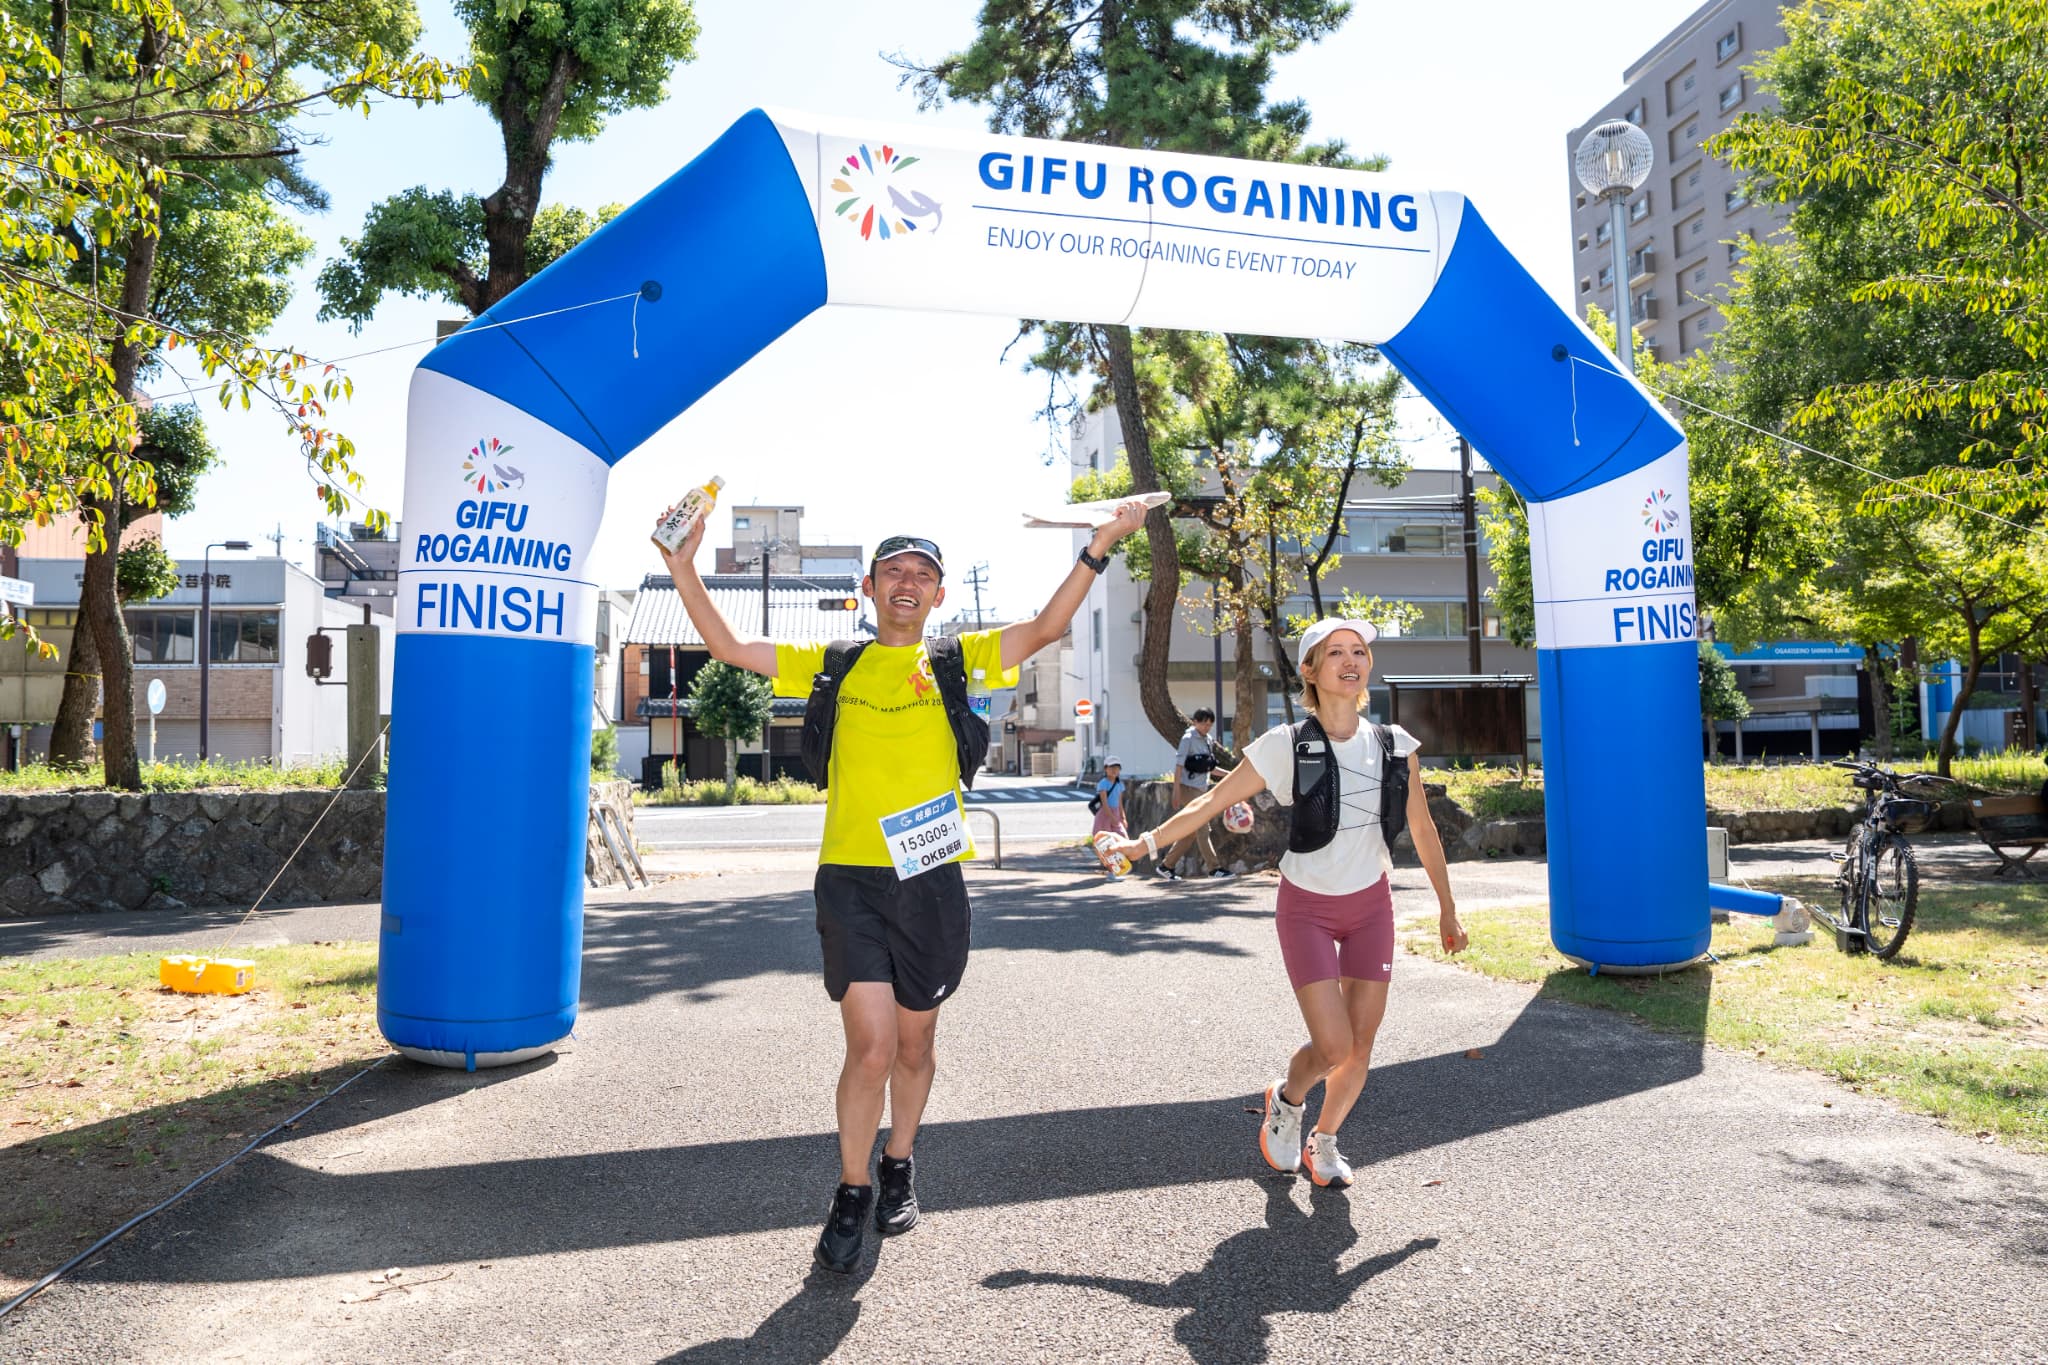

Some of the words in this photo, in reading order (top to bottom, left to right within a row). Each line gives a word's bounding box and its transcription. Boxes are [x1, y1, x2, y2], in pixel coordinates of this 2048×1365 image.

[977, 151, 1108, 201] GIFU
[1127, 165, 1419, 234] ROGAINING
[987, 226, 1054, 251] ENJOY
[1059, 232, 1106, 257] OUR
[1110, 237, 1222, 268] ROGAINING
[1226, 249, 1285, 273] EVENT
[1290, 256, 1358, 281] TODAY
[455, 499, 529, 533] GIFU
[416, 533, 572, 572] ROGAINING
[1642, 537, 1684, 563] GIFU
[416, 583, 565, 637] FINISH
[899, 821, 957, 854] 153G09-1
[921, 838, 962, 867] OKB総研
